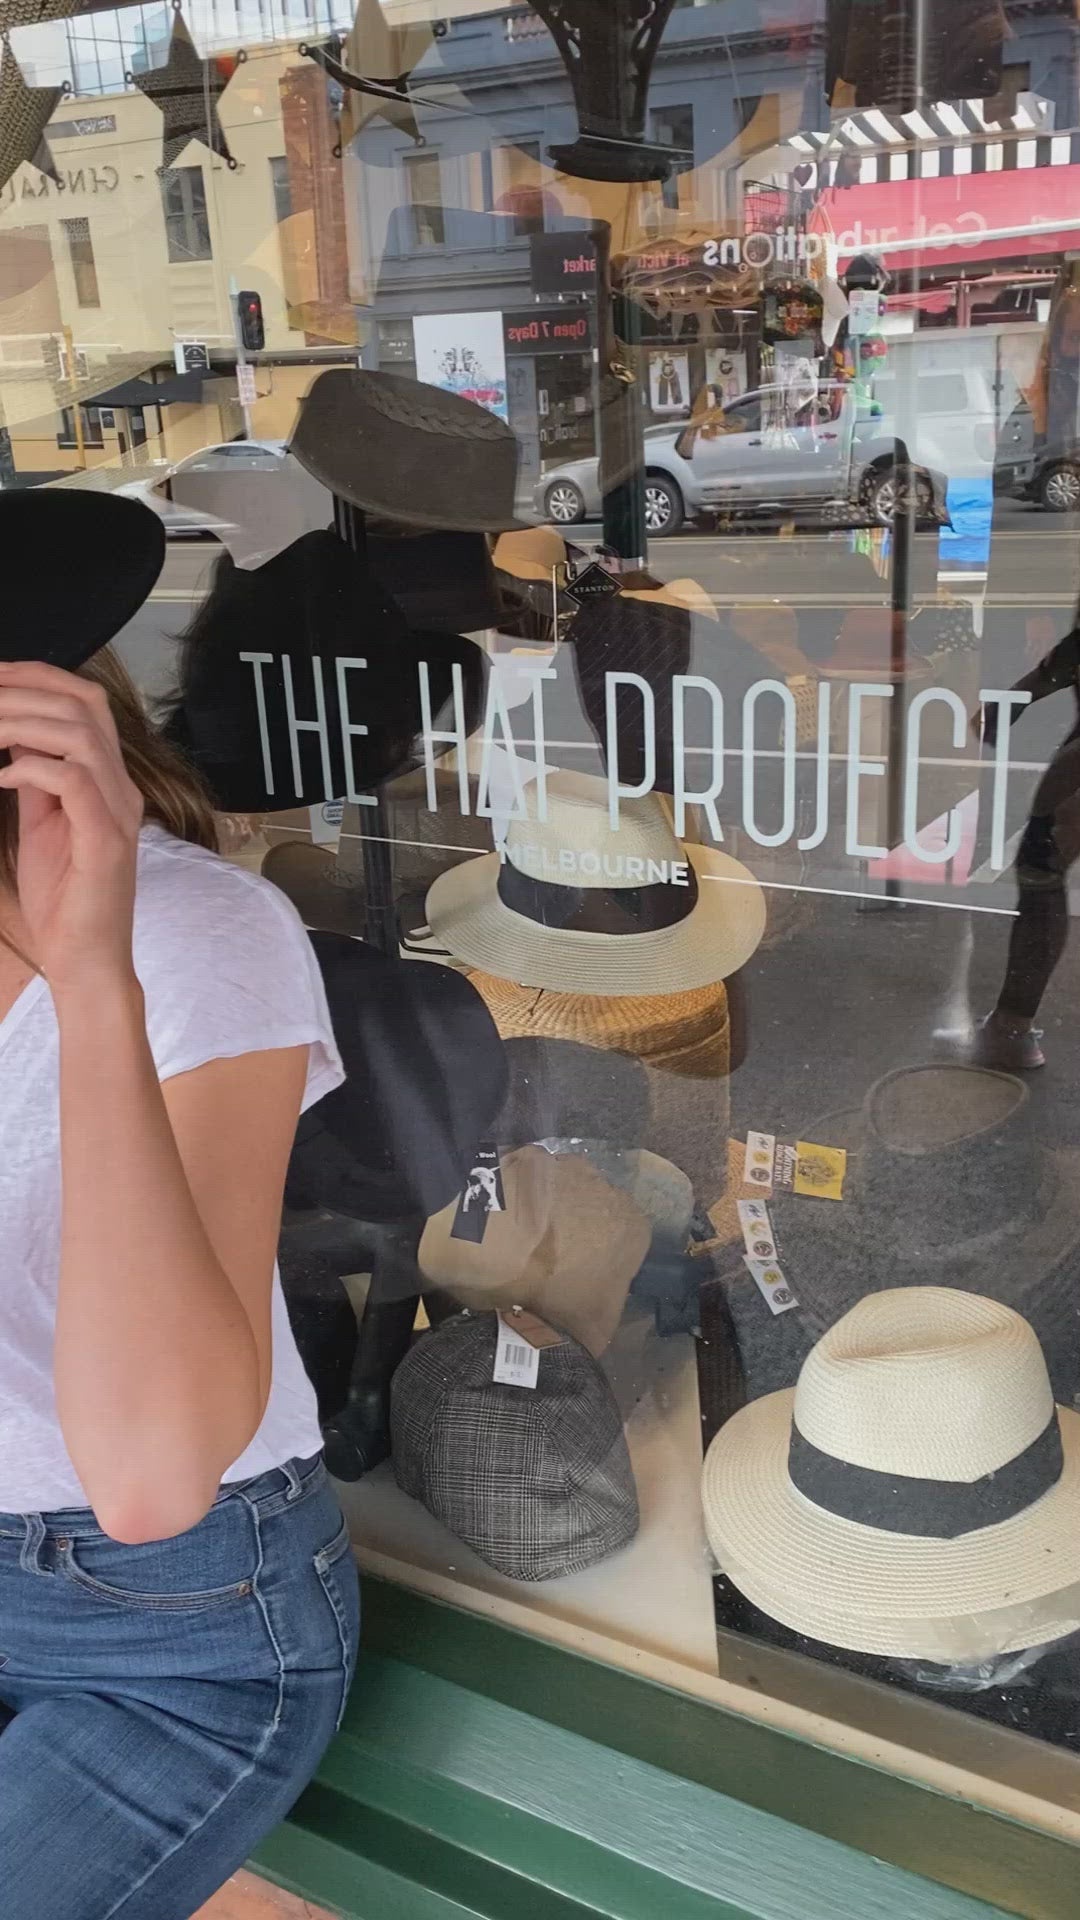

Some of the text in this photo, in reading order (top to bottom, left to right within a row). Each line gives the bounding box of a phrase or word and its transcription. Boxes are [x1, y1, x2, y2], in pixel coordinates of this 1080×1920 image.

[573, 584, 615, 594] STANTON
[239, 652, 1032, 870] THE HAT PROJECT
[500, 842, 690, 887] MELBOURNE
